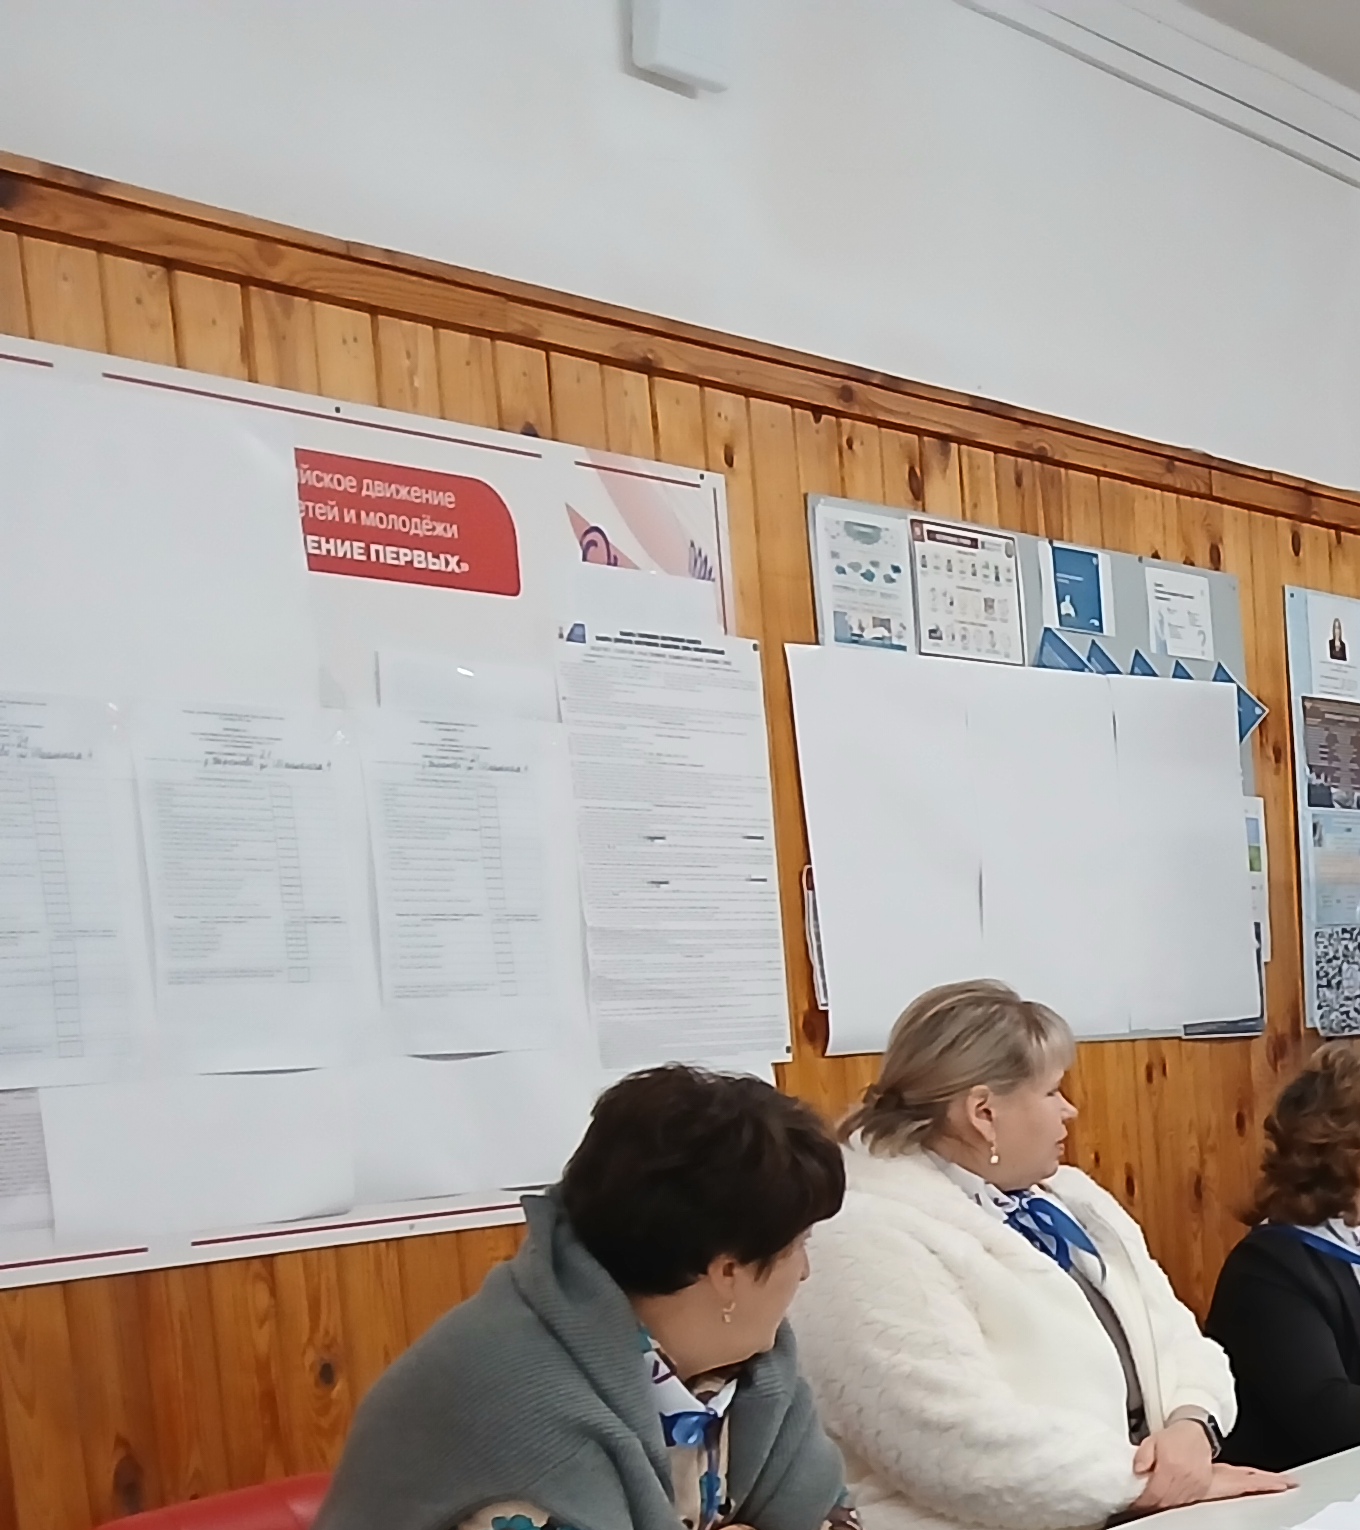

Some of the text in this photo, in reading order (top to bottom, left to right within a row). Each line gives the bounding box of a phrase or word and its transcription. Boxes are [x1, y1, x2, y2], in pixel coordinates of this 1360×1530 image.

[362, 478, 456, 509] движение
[343, 507, 357, 524] и
[360, 509, 459, 539] молодёжи
[369, 543, 470, 574] ПЕРВЫХ»
